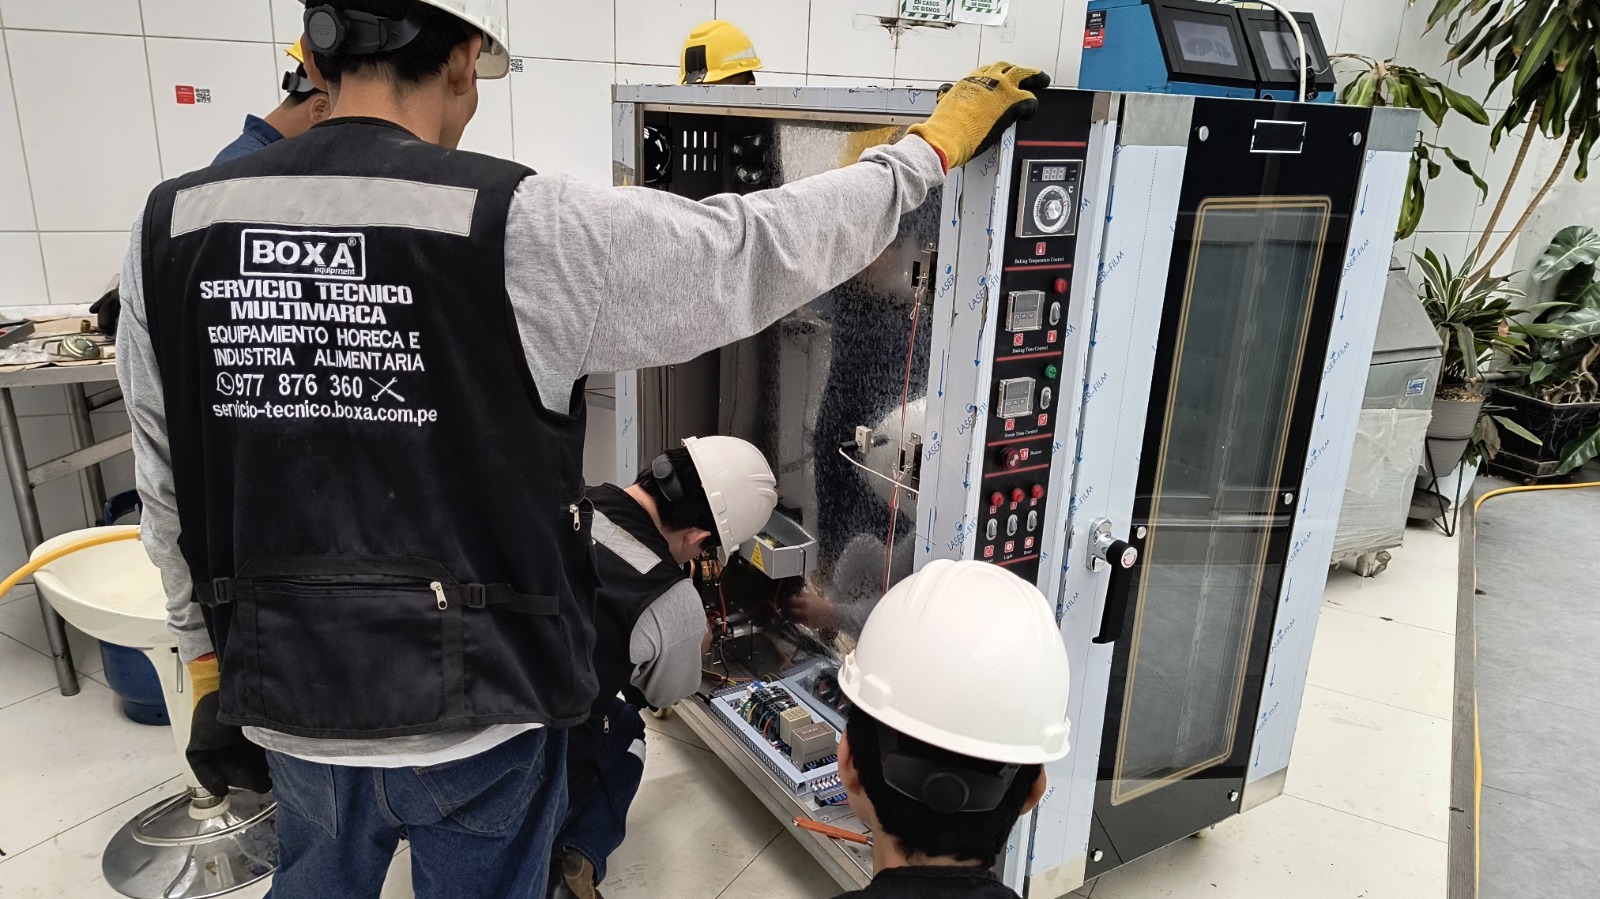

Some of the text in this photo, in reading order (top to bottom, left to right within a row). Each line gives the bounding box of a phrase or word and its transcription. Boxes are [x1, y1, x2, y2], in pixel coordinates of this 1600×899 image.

[314, 266, 356, 276] equipment
[200, 280, 413, 305] SERVICIO TECNICO
[230, 301, 387, 325] MULTIMARCA
[208, 326, 421, 349] EQUIPAMIENTO HORECA E
[215, 347, 425, 372] INDUSTRIA ALIMENTARIA
[235, 374, 363, 398] 977 876 360
[212, 400, 438, 426] servicio-tecnico.boxa.com.pe
